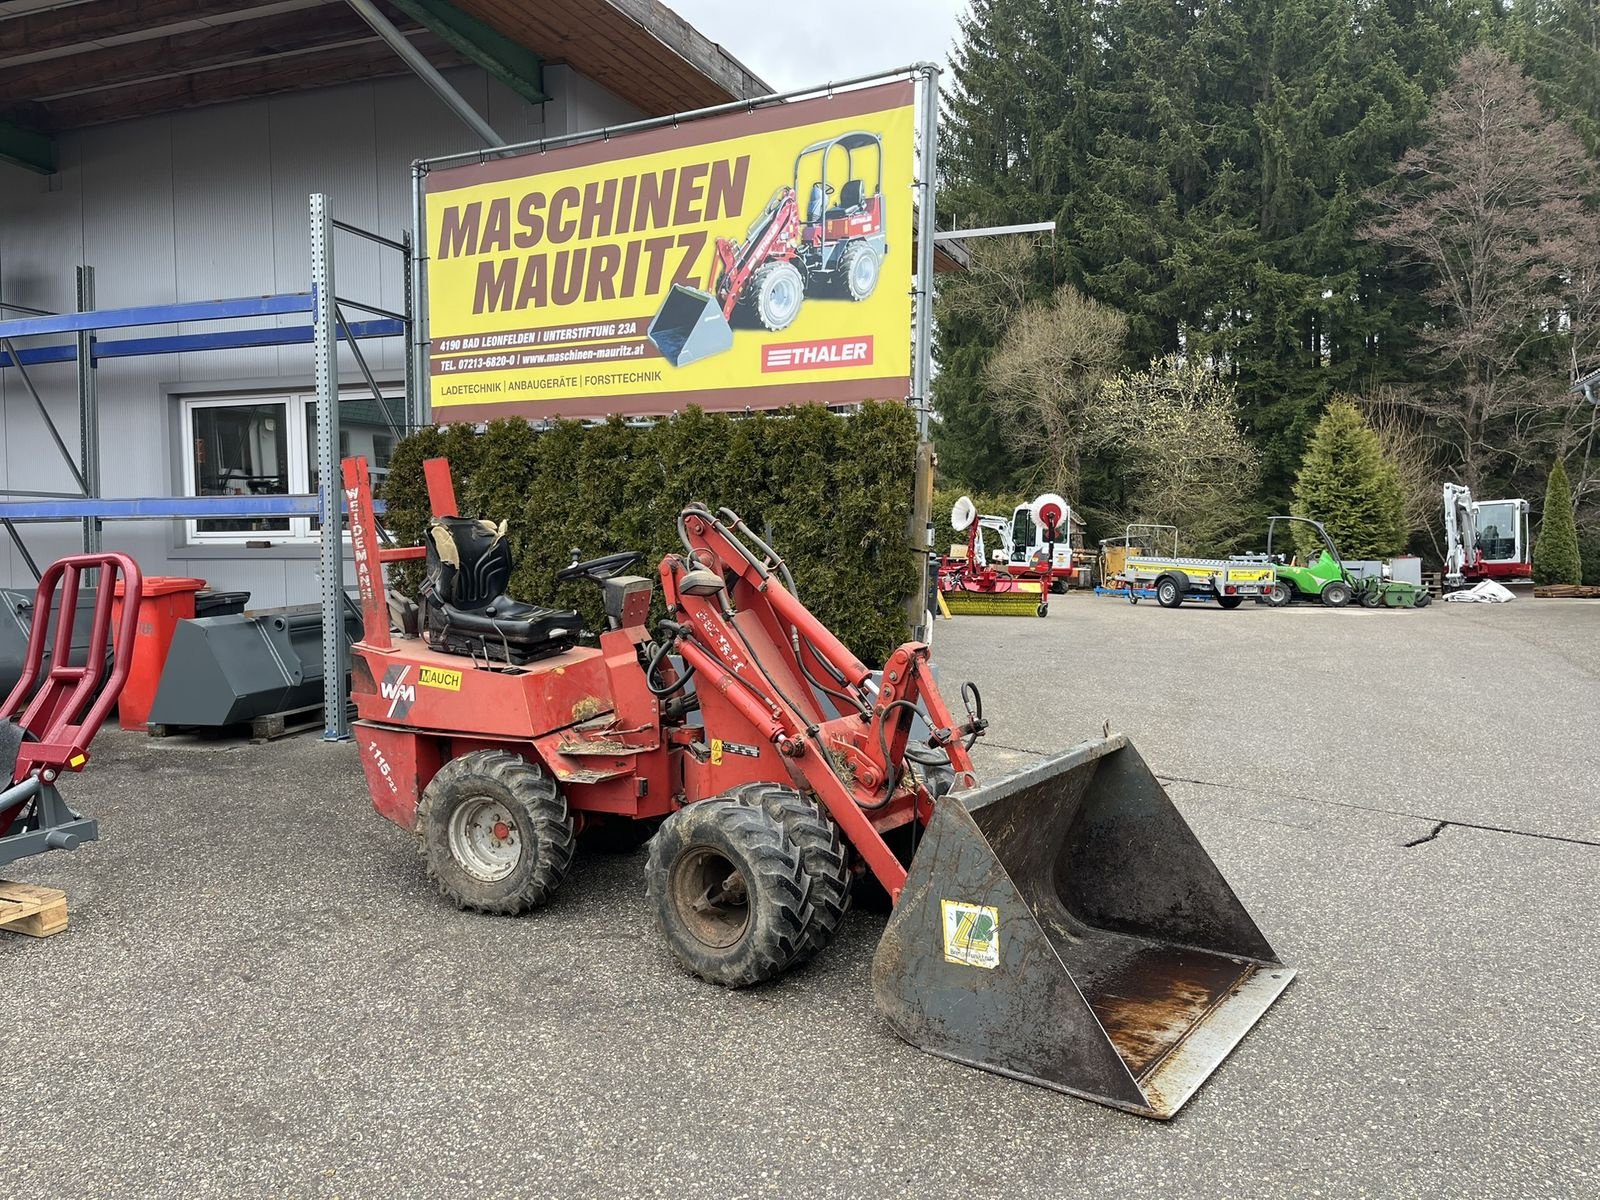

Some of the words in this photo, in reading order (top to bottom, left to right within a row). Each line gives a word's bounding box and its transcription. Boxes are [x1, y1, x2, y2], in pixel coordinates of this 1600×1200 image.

[438, 155, 750, 260] MASCHINEN
[472, 231, 708, 315] MAURITZ
[440, 339, 461, 352] 4190
[462, 338, 480, 350] BAD
[482, 332, 536, 348] LEONFELDEN
[543, 324, 616, 342] UNTERSTIFTUNG
[617, 322, 637, 335] 23A
[440, 360, 457, 372] TEL.
[458, 354, 515, 370] 07213-6820-0
[522, 344, 645, 365] www.maschinen-mauritz.at
[792, 342, 868, 365] THALER
[441, 382, 502, 396] LADETECHNIK
[508, 376, 578, 391] ANBAUGERÄTE
[584, 371, 662, 387] FORSTTECHNIK
[419, 668, 460, 687] MAUCH
